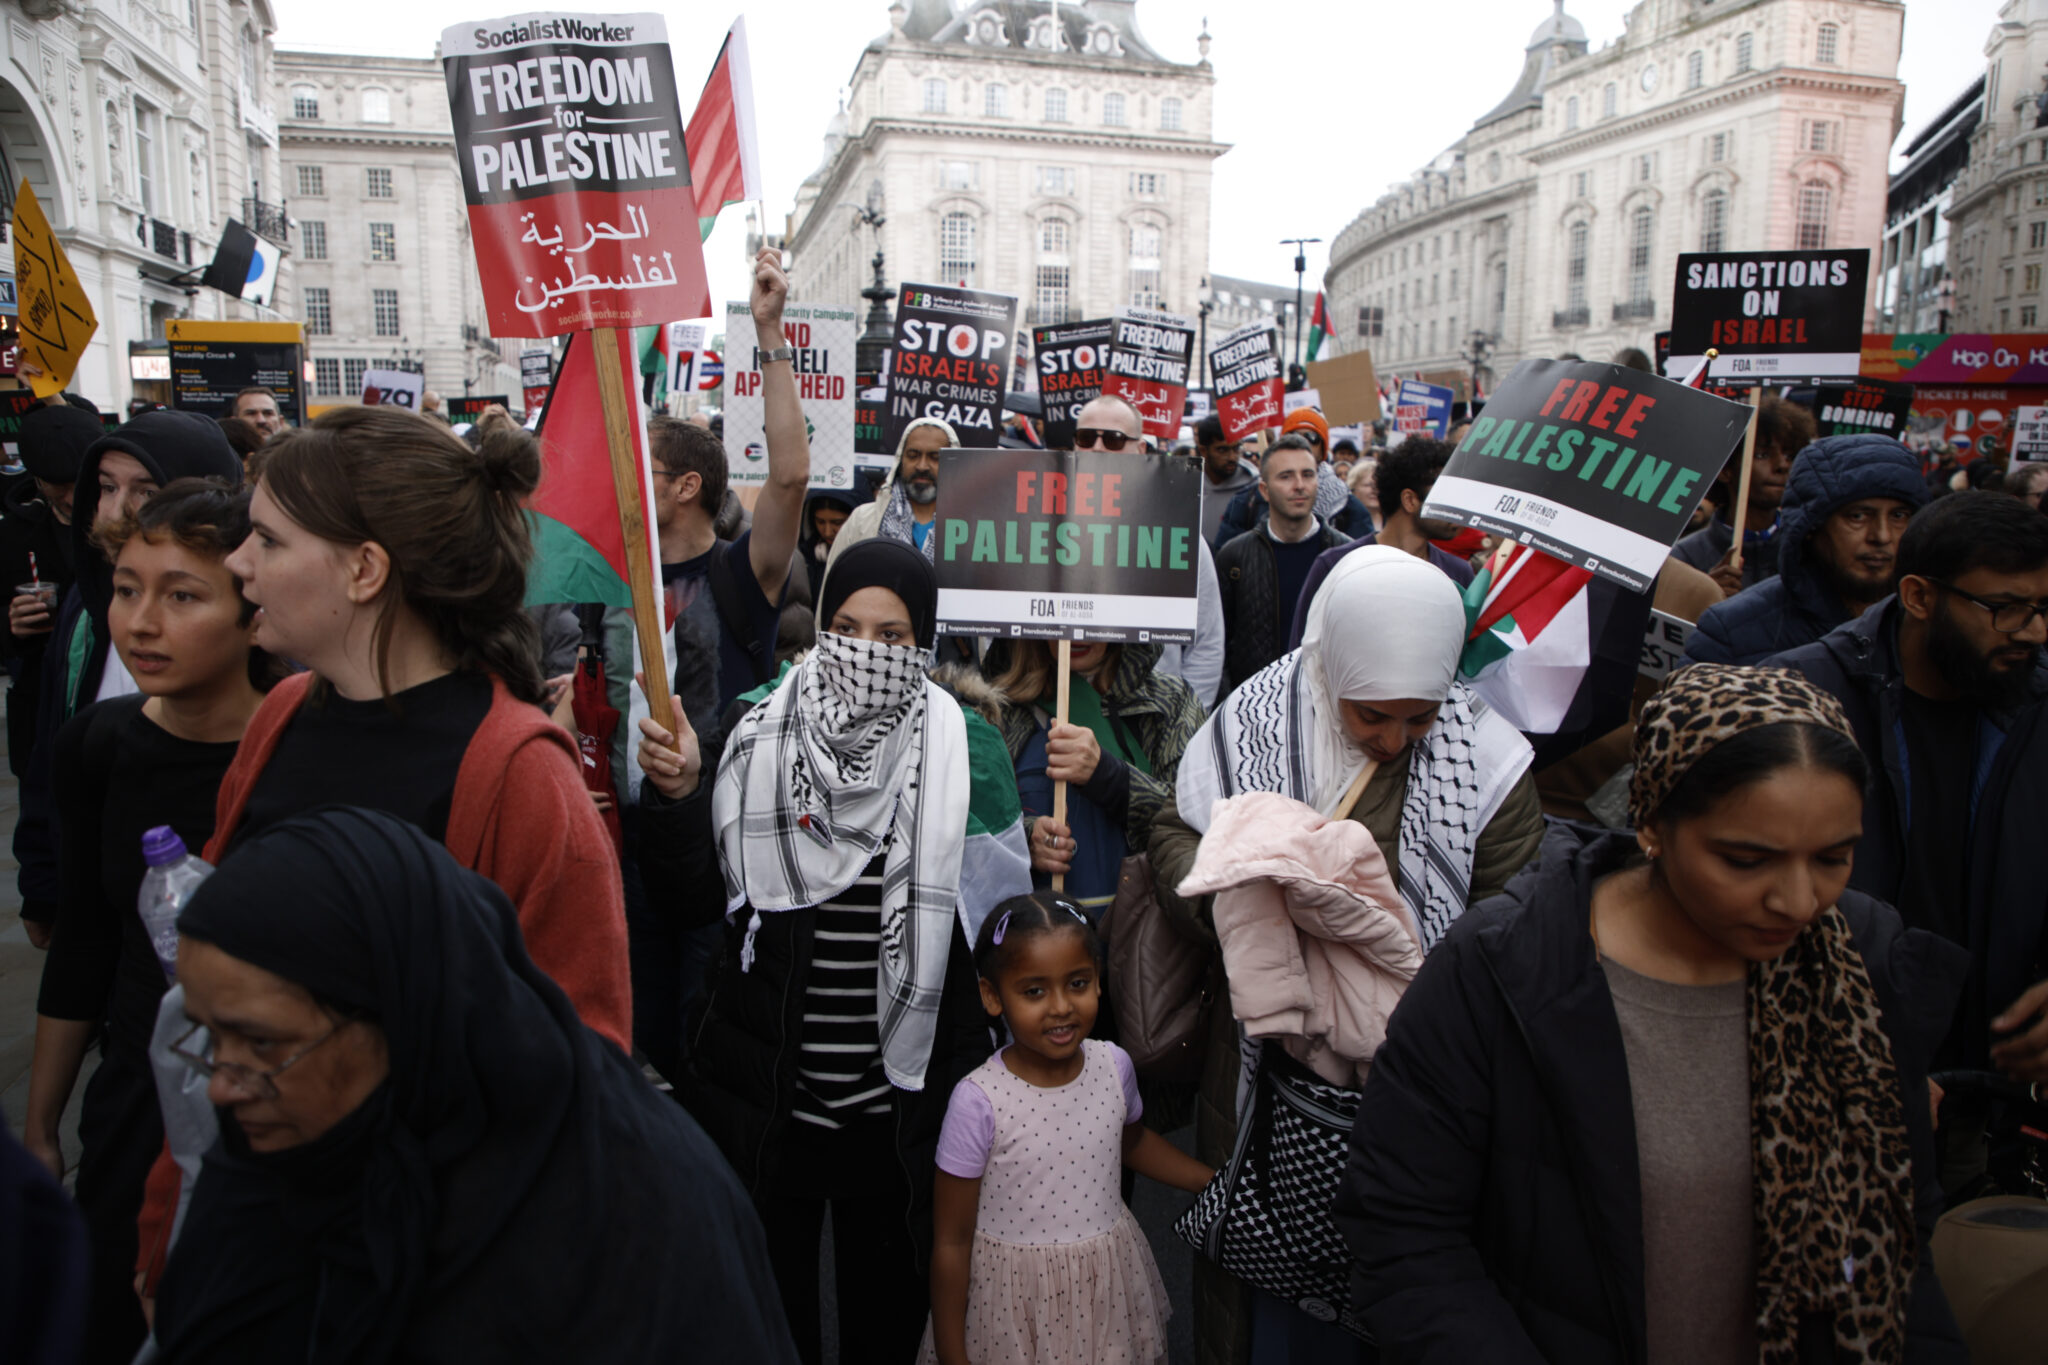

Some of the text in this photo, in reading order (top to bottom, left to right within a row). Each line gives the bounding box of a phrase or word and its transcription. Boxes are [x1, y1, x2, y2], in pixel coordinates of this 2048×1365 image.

[469, 56, 654, 115] FREEDOM
[554, 105, 585, 128] for
[472, 130, 676, 192] PALESTINE
[520, 203, 649, 256] الحرية
[515, 251, 677, 312] لفلسطين
[1687, 259, 1849, 289] SANCTIONS
[727, 304, 855, 321] Pales idarity Campaign
[904, 290, 932, 308] PFB
[1742, 290, 1780, 317] ON
[784, 322, 810, 347] ND
[899, 319, 1006, 360] STOP
[1119, 322, 1187, 353] FREEDOM
[1712, 319, 1808, 345] ISRAEL
[1213, 333, 1270, 370] FREEDOM
[1733, 358, 1751, 372] FOA
[1952, 347, 2048, 370] Hop On Ho
[896, 351, 1000, 386] ISRAEL'S
[1042, 368, 1106, 391] ISRAEL'
[1110, 351, 1186, 383] PALESTINE
[1216, 357, 1280, 396] PALESTINE
[734, 371, 845, 400] APHEID
[894, 377, 931, 395] WAR
[936, 383, 998, 404] CRIMES
[1044, 391, 1072, 404] WAR
[1917, 389, 2008, 400] TICKETS HERE
[892, 396, 994, 429] IN GAZA
[1397, 405, 1427, 417] MUST
[1540, 378, 1656, 439] FREE
[1842, 390, 1884, 409] STOP
[1047, 406, 1065, 422] IN
[1821, 405, 1895, 429] BOMBING
[1461, 417, 1702, 515] PALESTINE
[1016, 470, 1122, 517] FREE
[1494, 494, 1559, 519] FOA FRIENDS
[944, 518, 1190, 570] PALESTINE
[1030, 599, 1095, 617] FOA FRIENDS
